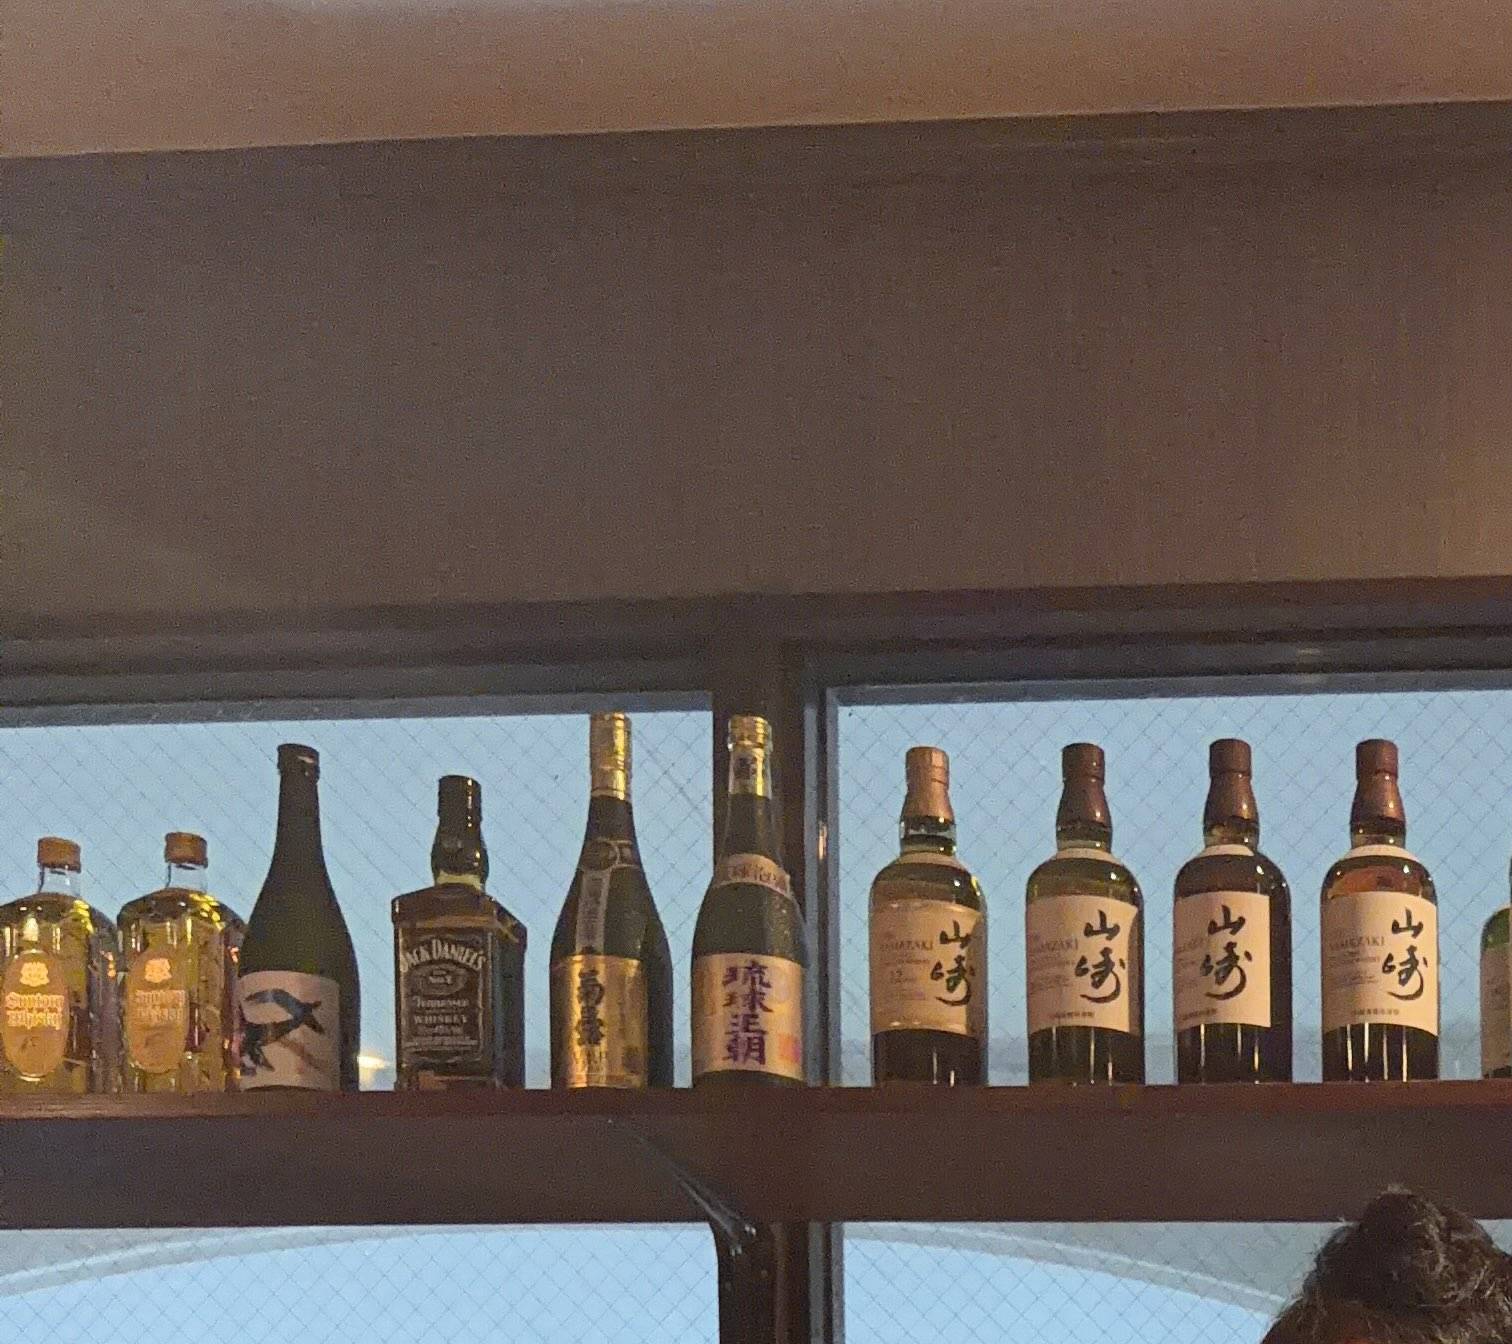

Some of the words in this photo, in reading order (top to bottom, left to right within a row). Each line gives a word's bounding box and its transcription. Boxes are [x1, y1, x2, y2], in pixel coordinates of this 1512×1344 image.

[400, 943, 430, 972] JACK
[721, 960, 774, 1065] 琉球王朝
